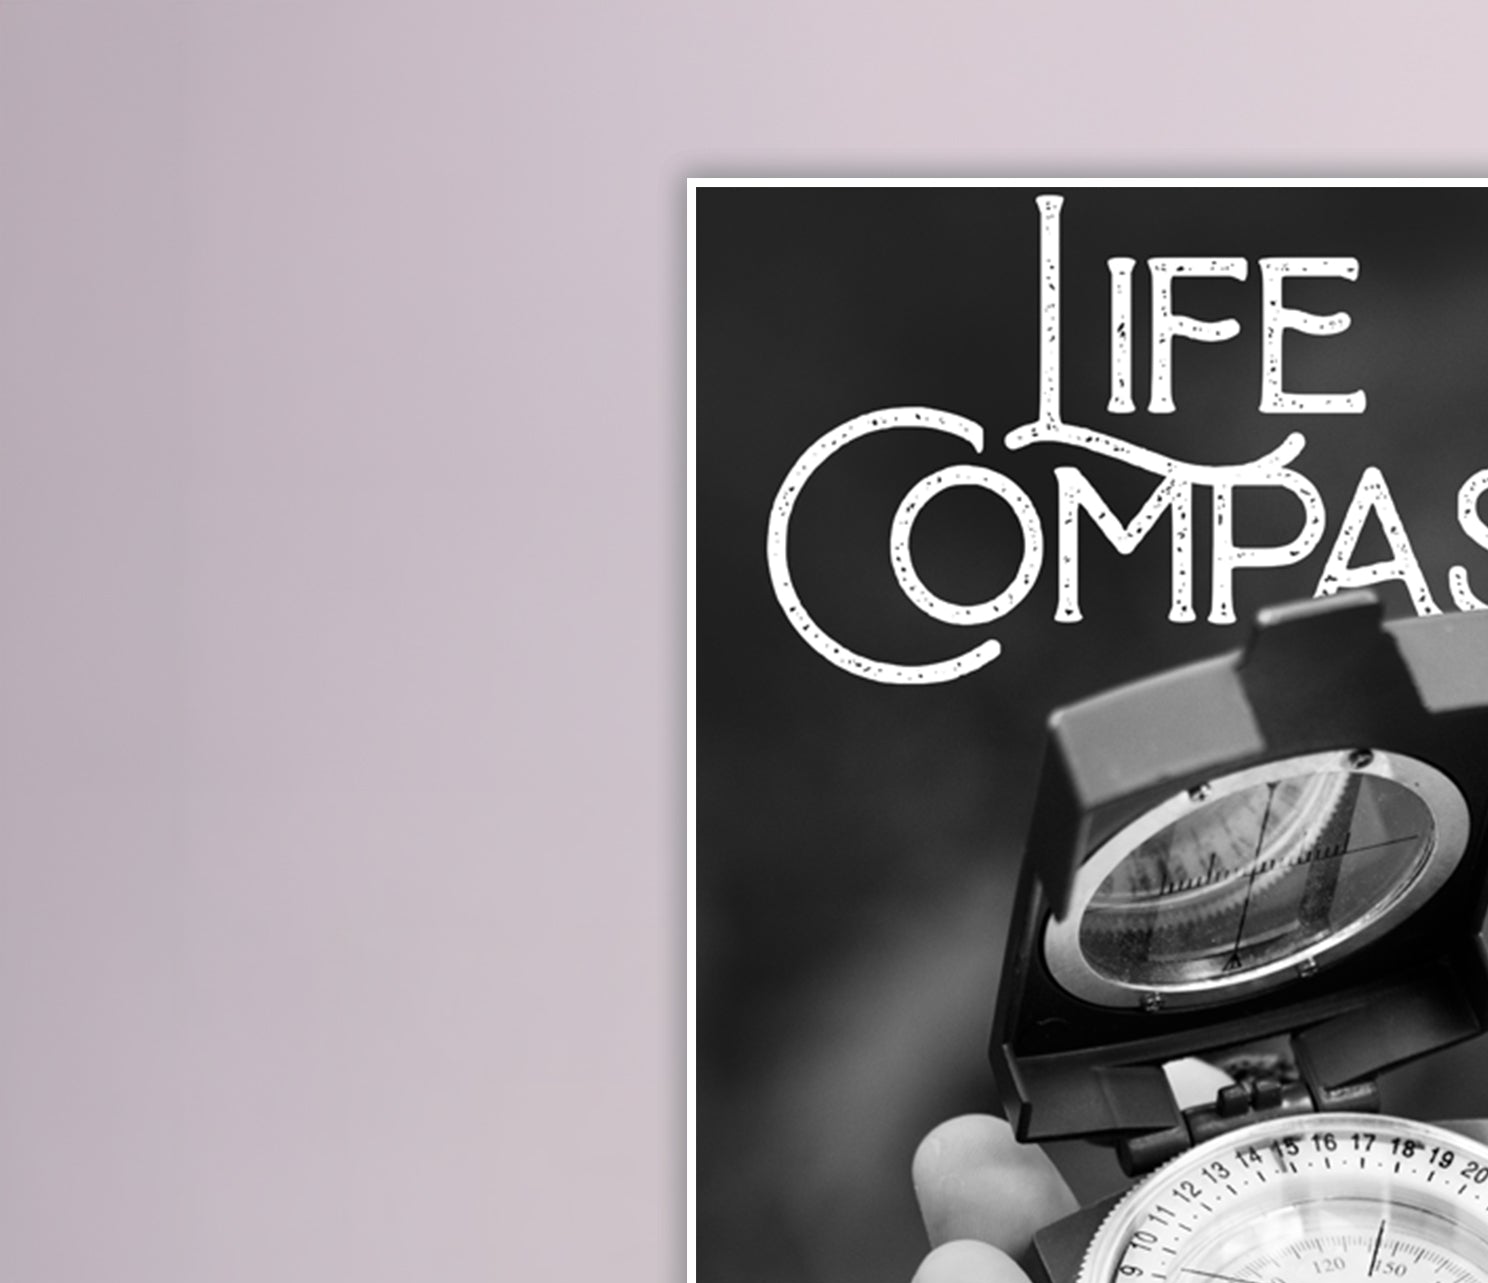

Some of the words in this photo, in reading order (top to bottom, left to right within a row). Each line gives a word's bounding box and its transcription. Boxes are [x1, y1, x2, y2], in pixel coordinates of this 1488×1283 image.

[1129, 1230, 1158, 1252] 10
[1149, 1204, 1176, 1226] 11
[1172, 1179, 1203, 1203] 12
[1201, 1161, 1231, 1184] 13
[1235, 1146, 1263, 1169] 14
[1270, 1135, 1300, 1157] 15
[1311, 1132, 1338, 1152] 16
[1351, 1133, 1377, 1151] 17
[1391, 1137, 1415, 1158] 18
[1428, 1146, 1455, 1170] 19
[1314, 1256, 1346, 1275] 120
[1373, 1259, 1408, 1278] 150
